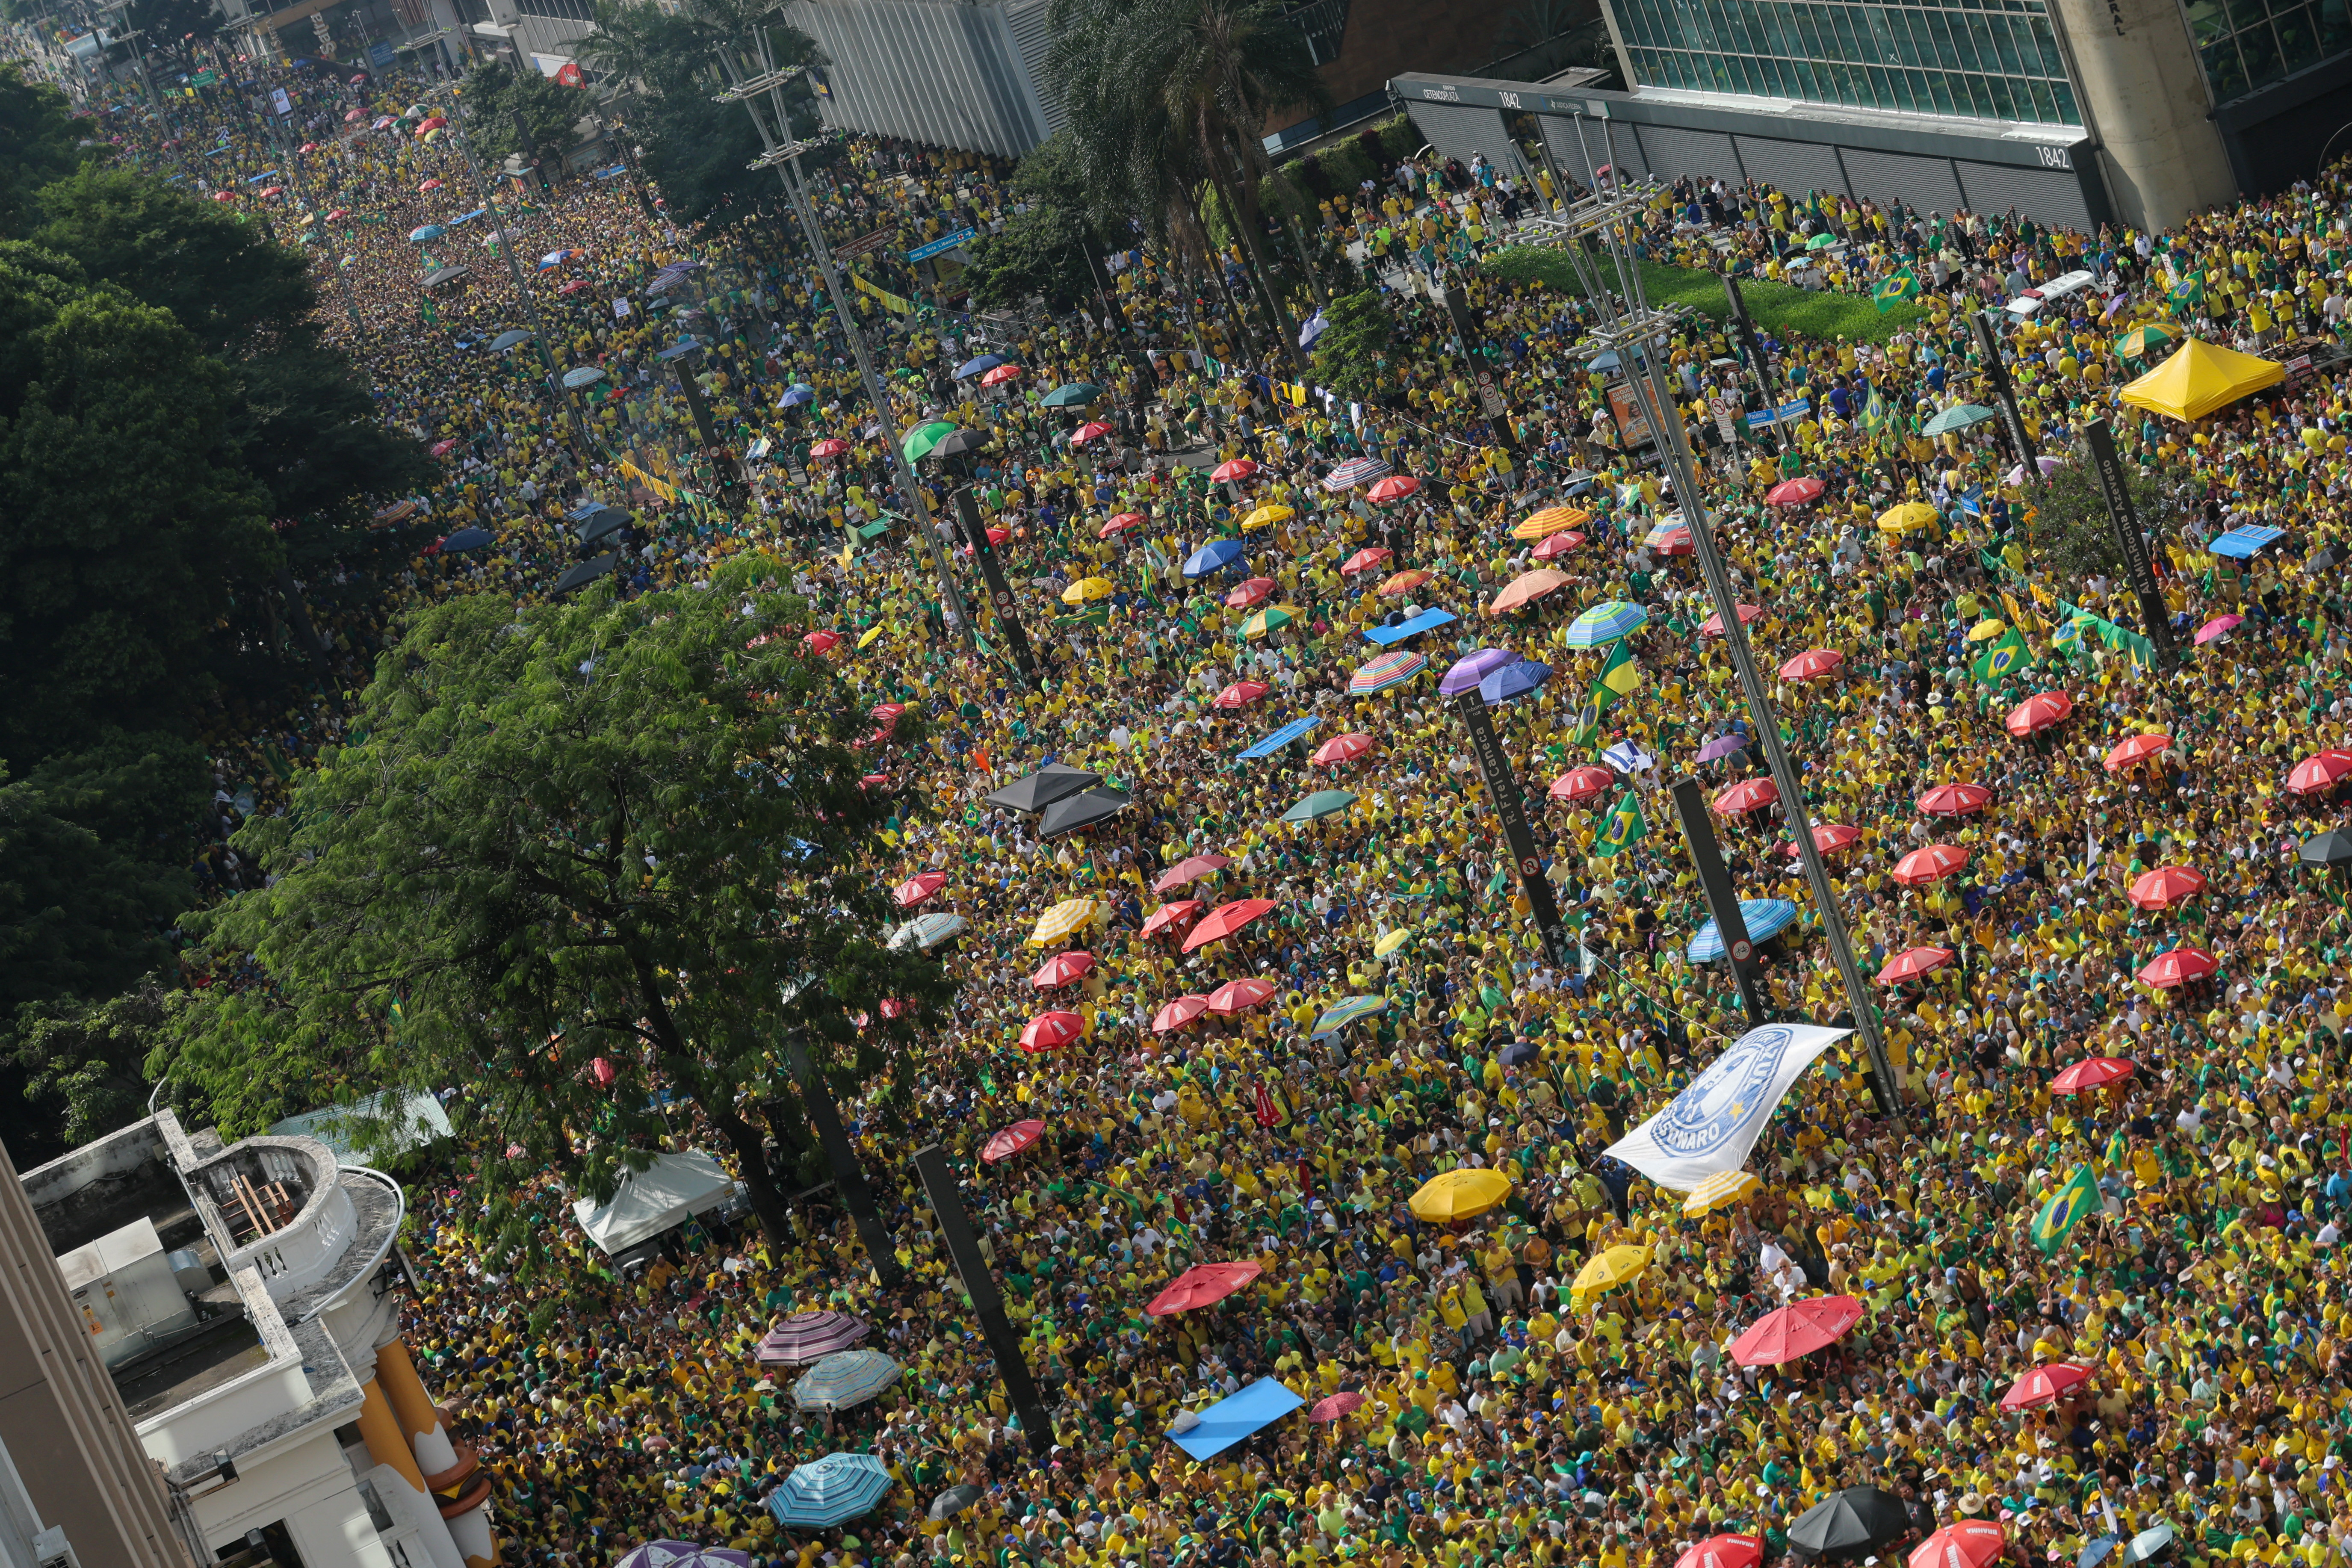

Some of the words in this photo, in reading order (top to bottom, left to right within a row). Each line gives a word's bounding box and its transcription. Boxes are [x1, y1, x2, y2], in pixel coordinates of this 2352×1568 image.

[311, 12, 335, 55] Safra
[1424, 89, 1460, 101] CETENCOPLAZA
[1499, 92, 1522, 109] 1842
[2036, 146, 2069, 168] 1842
[838, 245, 851, 255] Centro
[857, 232, 882, 247] Convenções
[938, 237, 956, 248] Libanês
[613, 297, 626, 306] SORRY
[1479, 373, 1489, 381] 50
[1786, 400, 1806, 411] Azevedo
[2000, 398, 2020, 445] Paulista
[1966, 484, 1980, 496] Azevedo
[2104, 460, 2124, 510] Azevedo
[2140, 579, 2151, 594] Al.
[998, 594, 1007, 602] 50
[1466, 703, 1483, 714] Próxima
[2041, 698, 2061, 711] BRAHMA
[2018, 707, 2030, 726] BRAHMA
[1344, 740, 1356, 751] BRAHMA
[1477, 727, 1500, 777] Caneca
[2151, 746, 2165, 754] BRAHMA
[2337, 772, 2348, 782] BRAHMA
[1494, 779, 1511, 809] Frei
[1719, 791, 1734, 805] BRAHMA
[1924, 791, 1941, 804] BRAHMA
[1957, 792, 1970, 804] BRAHMA
[1506, 811, 1517, 825] R.
[1900, 855, 1918, 873] BRAHMA
[1932, 850, 1950, 867] BRAHMA
[2176, 872, 2198, 883] BRAHMA
[2151, 880, 2164, 899] BRAHMA
[2192, 952, 2210, 963] BRAHMA
[1060, 962, 1070, 976] BRAHMA
[1925, 963, 1939, 973] BRAHMA
[2165, 960, 2173, 976] BRAHMA
[1247, 986, 1263, 995] BRAHMA
[1219, 992, 1232, 1007] BRAHMA
[1025, 1025, 1038, 1043] BRAHMA
[1052, 1020, 1067, 1036] BRAHMA
[2101, 1062, 2119, 1073] BRAHMA
[2065, 1069, 2080, 1084] BRAHMA
[2085, 1083, 2101, 1092] BRAHMA
[1260, 1096, 1269, 1116] BRAHMA
[1013, 1131, 1026, 1142] BRAHMA
[986, 1138, 998, 1155] BRAHMA
[1232, 1274, 1248, 1285] Budweiser
[1162, 1302, 1183, 1310] Budweiser
[1833, 1316, 1849, 1331] Budweiser
[1754, 1351, 1778, 1359] Budweiser
[2059, 1363, 2083, 1372] BRAHMA
[2062, 1383, 2077, 1394] BRAHMA
[1727, 1538, 1755, 1548] BRAHMA
[1911, 1541, 1934, 1565] BRAHMA
